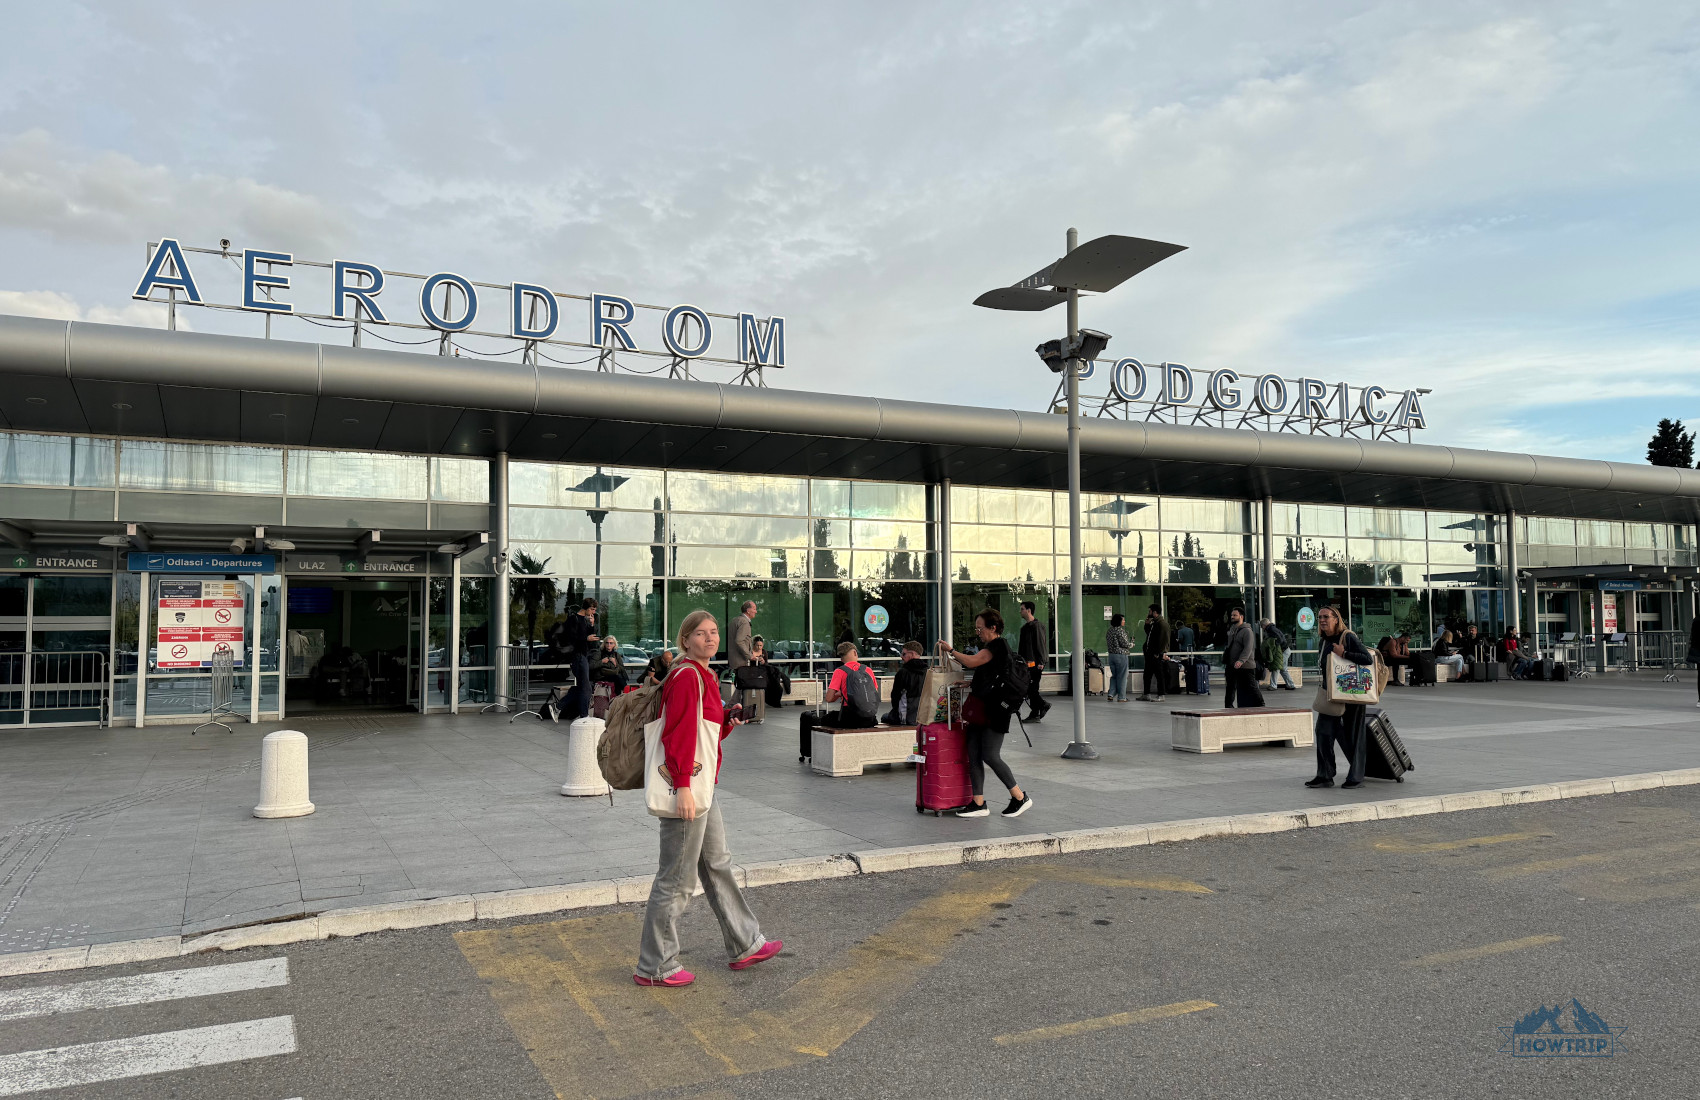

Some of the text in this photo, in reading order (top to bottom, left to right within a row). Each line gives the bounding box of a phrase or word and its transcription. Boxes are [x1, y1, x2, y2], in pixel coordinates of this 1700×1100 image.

[132, 237, 786, 368] AERODROM
[35, 557, 98, 569] ENTRANCE
[166, 558, 204, 567] Odlasci
[211, 558, 263, 568] Departures
[299, 561, 326, 570] ULAZ
[363, 562, 415, 572] ENTRANCE
